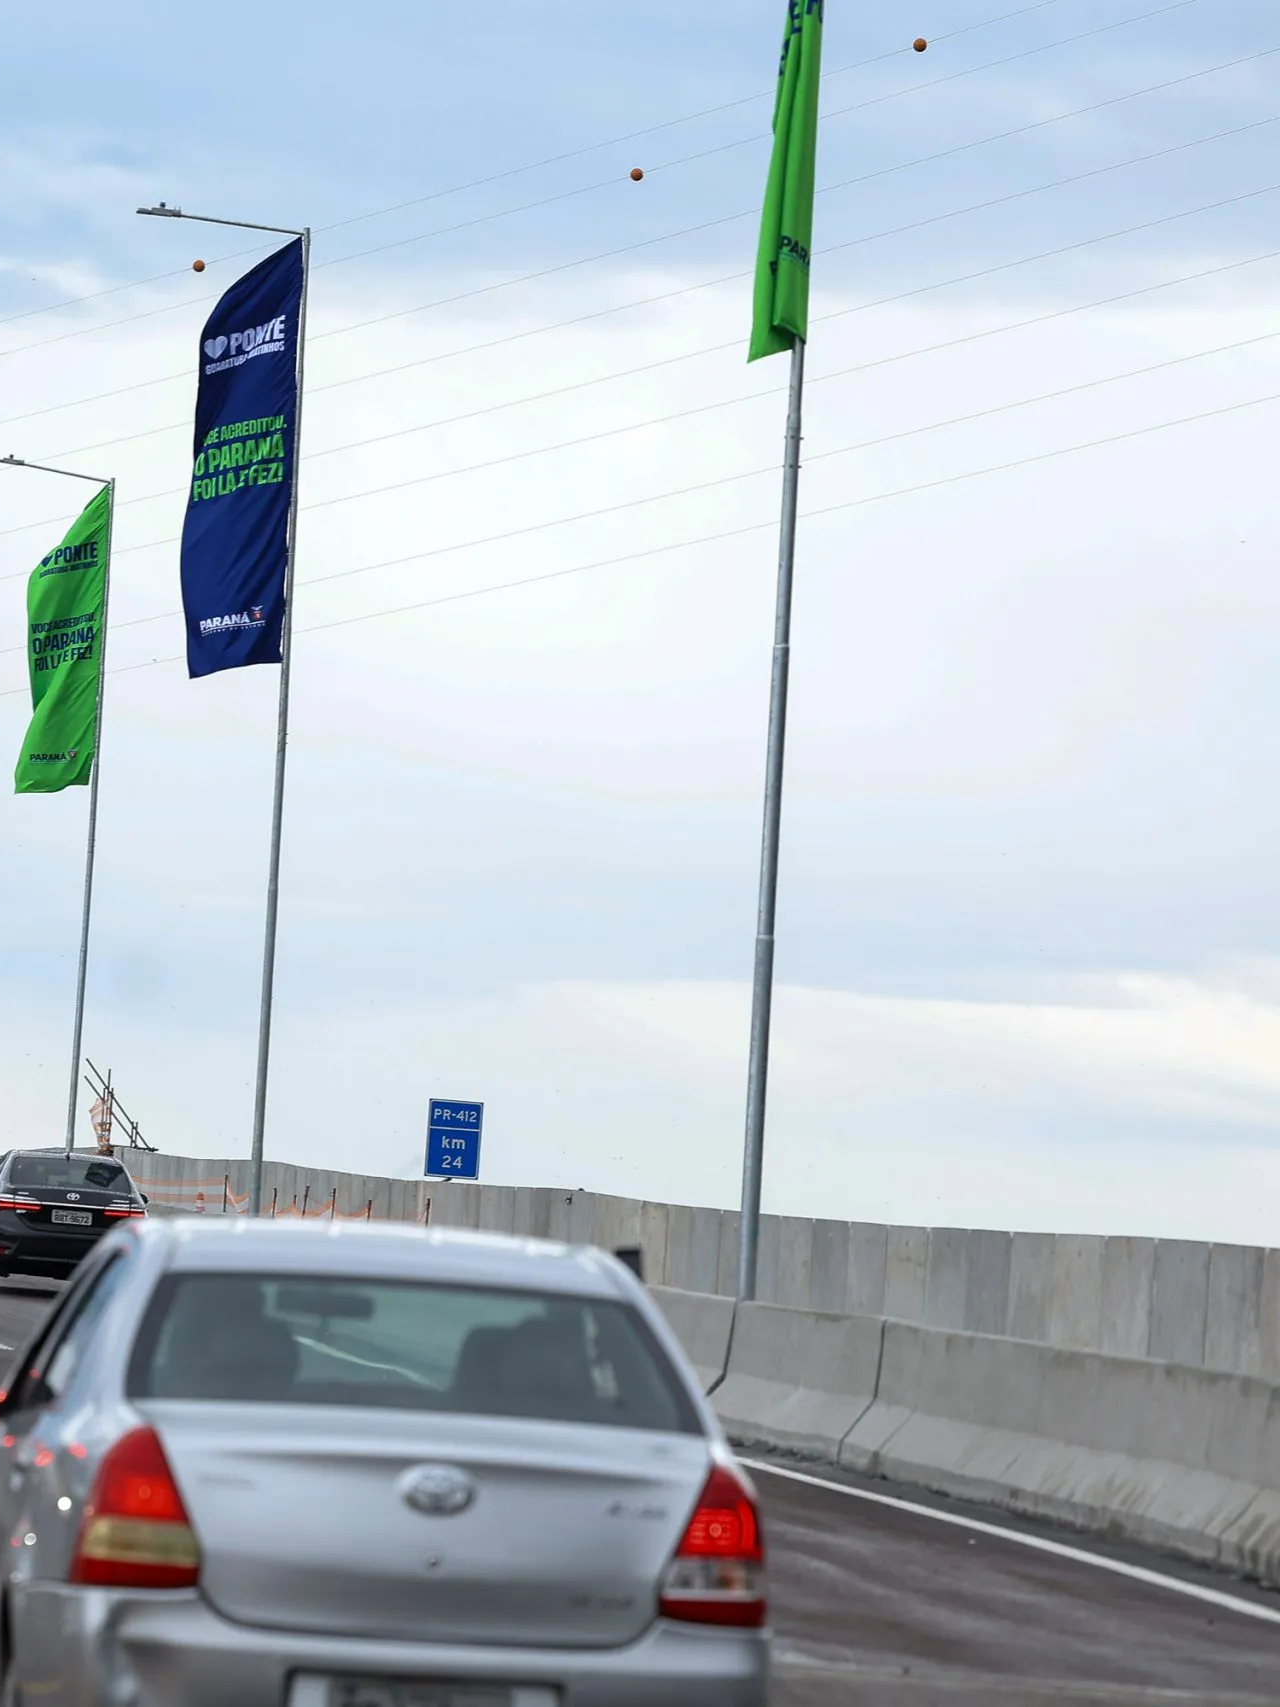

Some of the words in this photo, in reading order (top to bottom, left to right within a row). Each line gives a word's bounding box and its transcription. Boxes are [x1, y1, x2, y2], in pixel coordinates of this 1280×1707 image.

[230, 315, 286, 355] PONTE
[195, 453, 205, 476] O
[208, 431, 285, 473] PARANÁ
[193, 478, 217, 501] FOI
[248, 462, 283, 485] FEZ!
[55, 541, 98, 565] PONTE
[200, 611, 250, 631] PARANÁ
[32, 637, 42, 655] O
[433, 1108, 477, 1122] PR-412
[441, 1136, 465, 1150] km
[441, 1155, 463, 1169] 24
